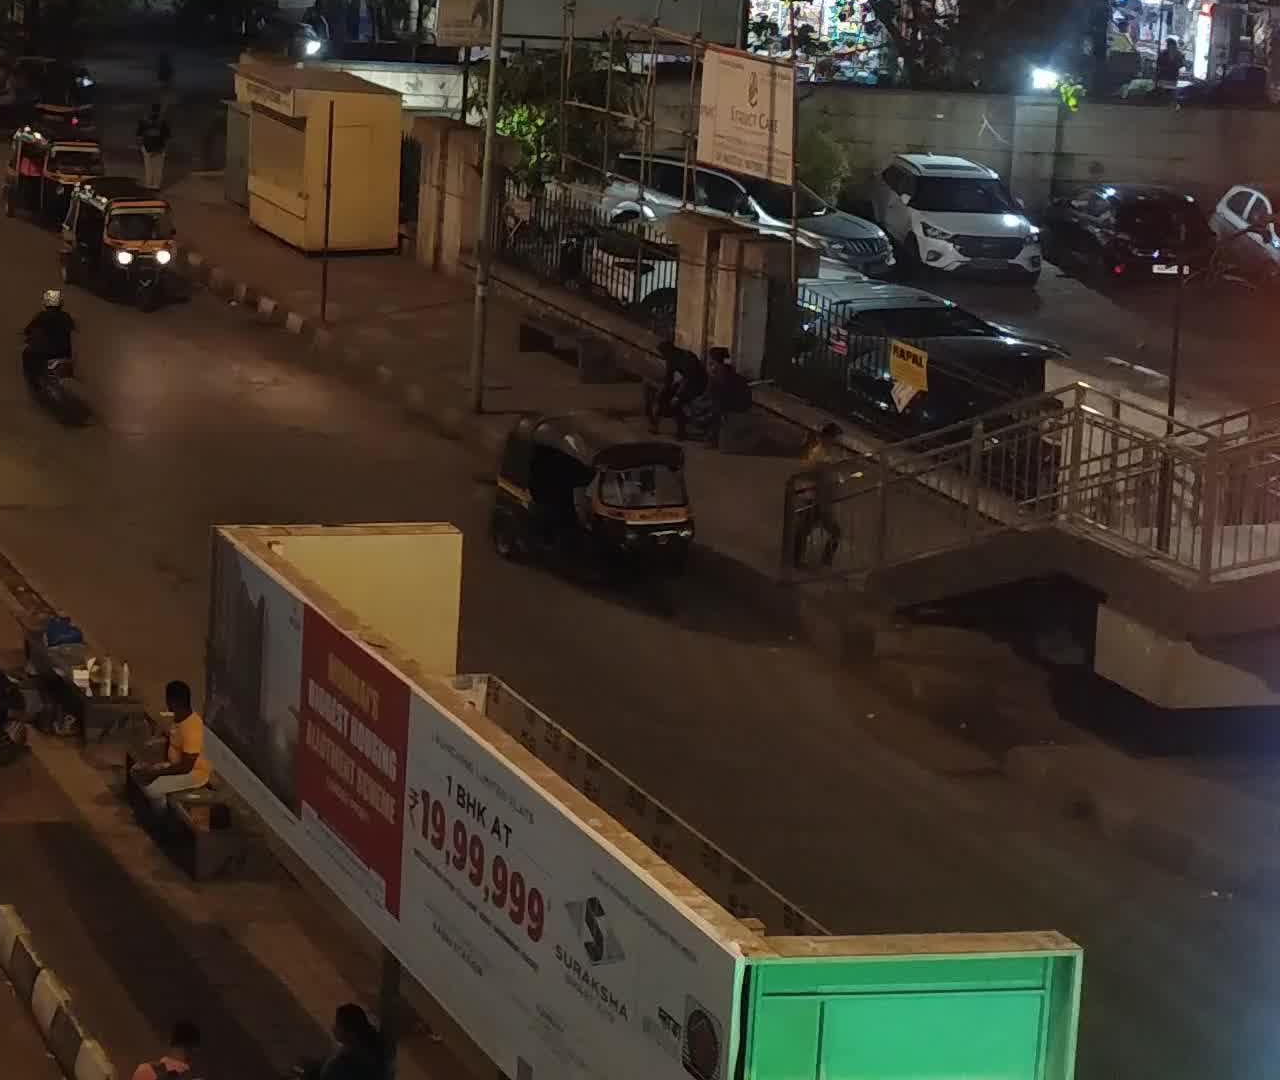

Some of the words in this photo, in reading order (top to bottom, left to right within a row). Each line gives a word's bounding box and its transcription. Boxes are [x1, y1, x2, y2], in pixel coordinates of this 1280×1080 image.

[447, 775, 453, 797] 1
[456, 783, 488, 829] BHK
[491, 816, 513, 849] AT
[554, 943, 629, 1022] SURAKSHA
